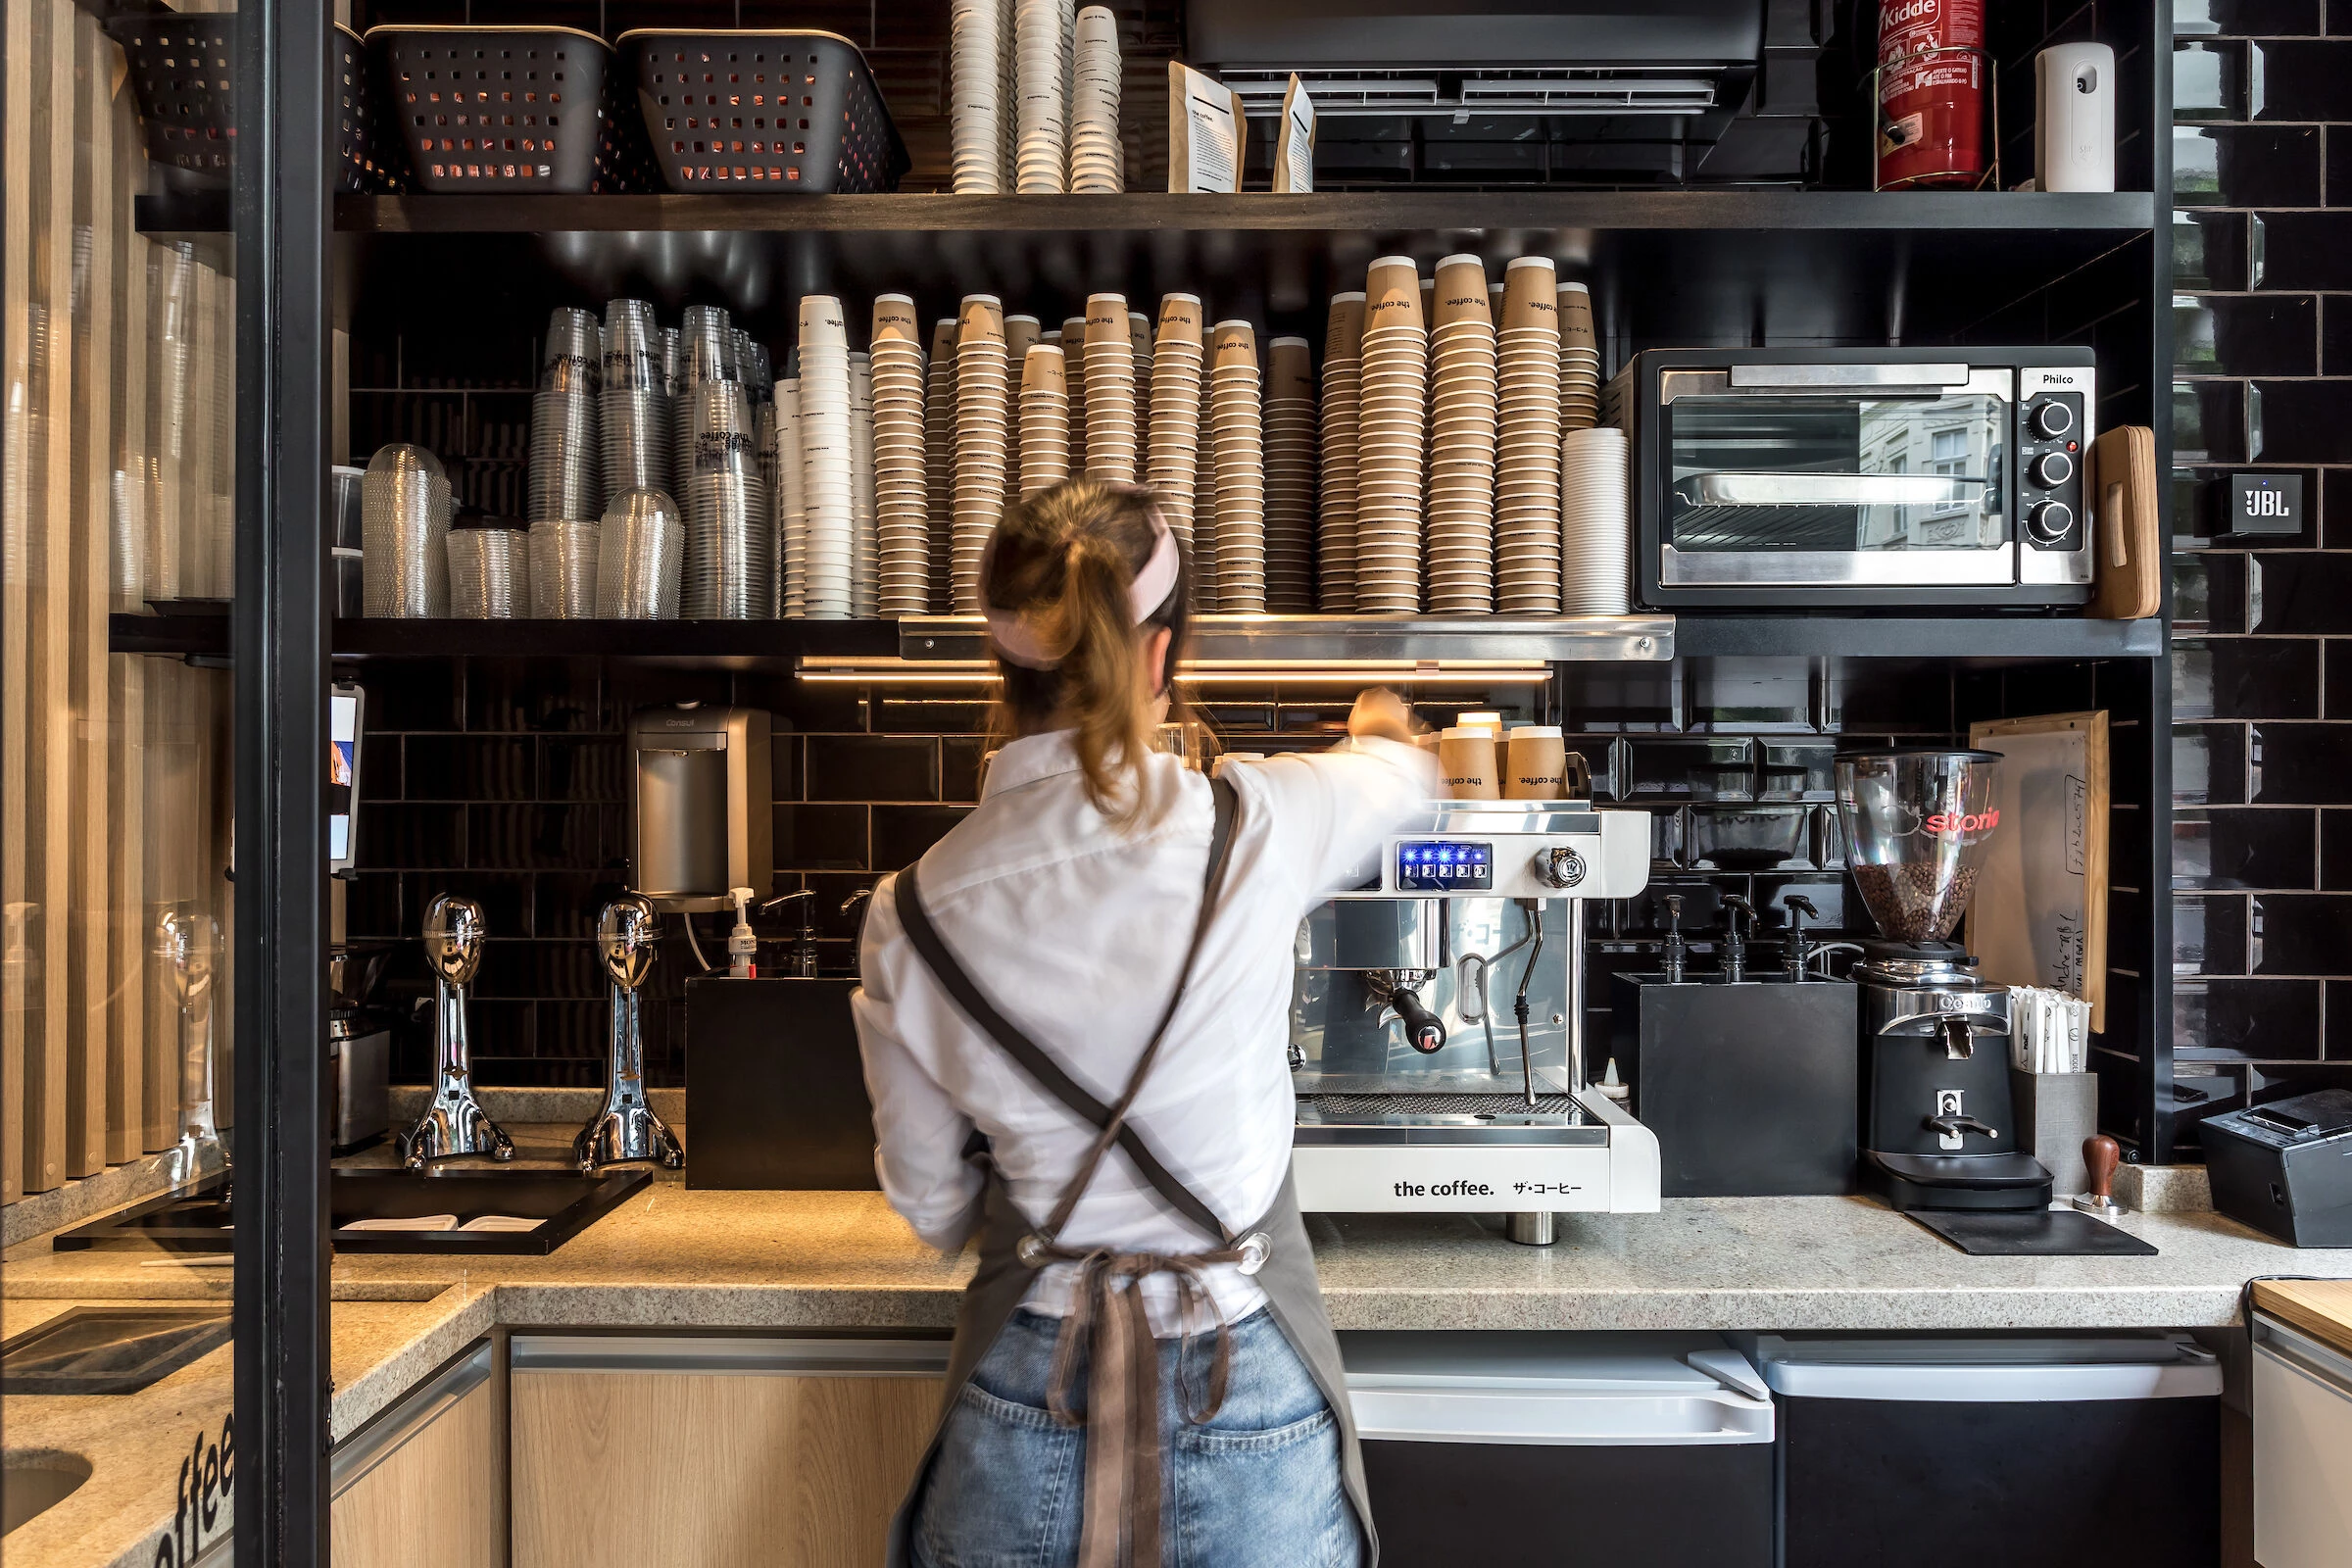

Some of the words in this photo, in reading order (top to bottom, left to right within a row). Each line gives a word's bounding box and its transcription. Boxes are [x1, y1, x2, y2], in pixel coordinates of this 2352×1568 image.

[1885, 0, 1936, 30] Kidde
[1528, 302, 1553, 311] coffee.
[2043, 374, 2074, 384] Philco
[2245, 490, 2289, 516] JBL
[1519, 777, 1548, 786] coffee.
[1550, 777, 1562, 786] the
[1394, 1181, 1425, 1197] the
[1431, 1180, 1494, 1197] coffee.
[1513, 1181, 1582, 1195] ザ・コーヒー
